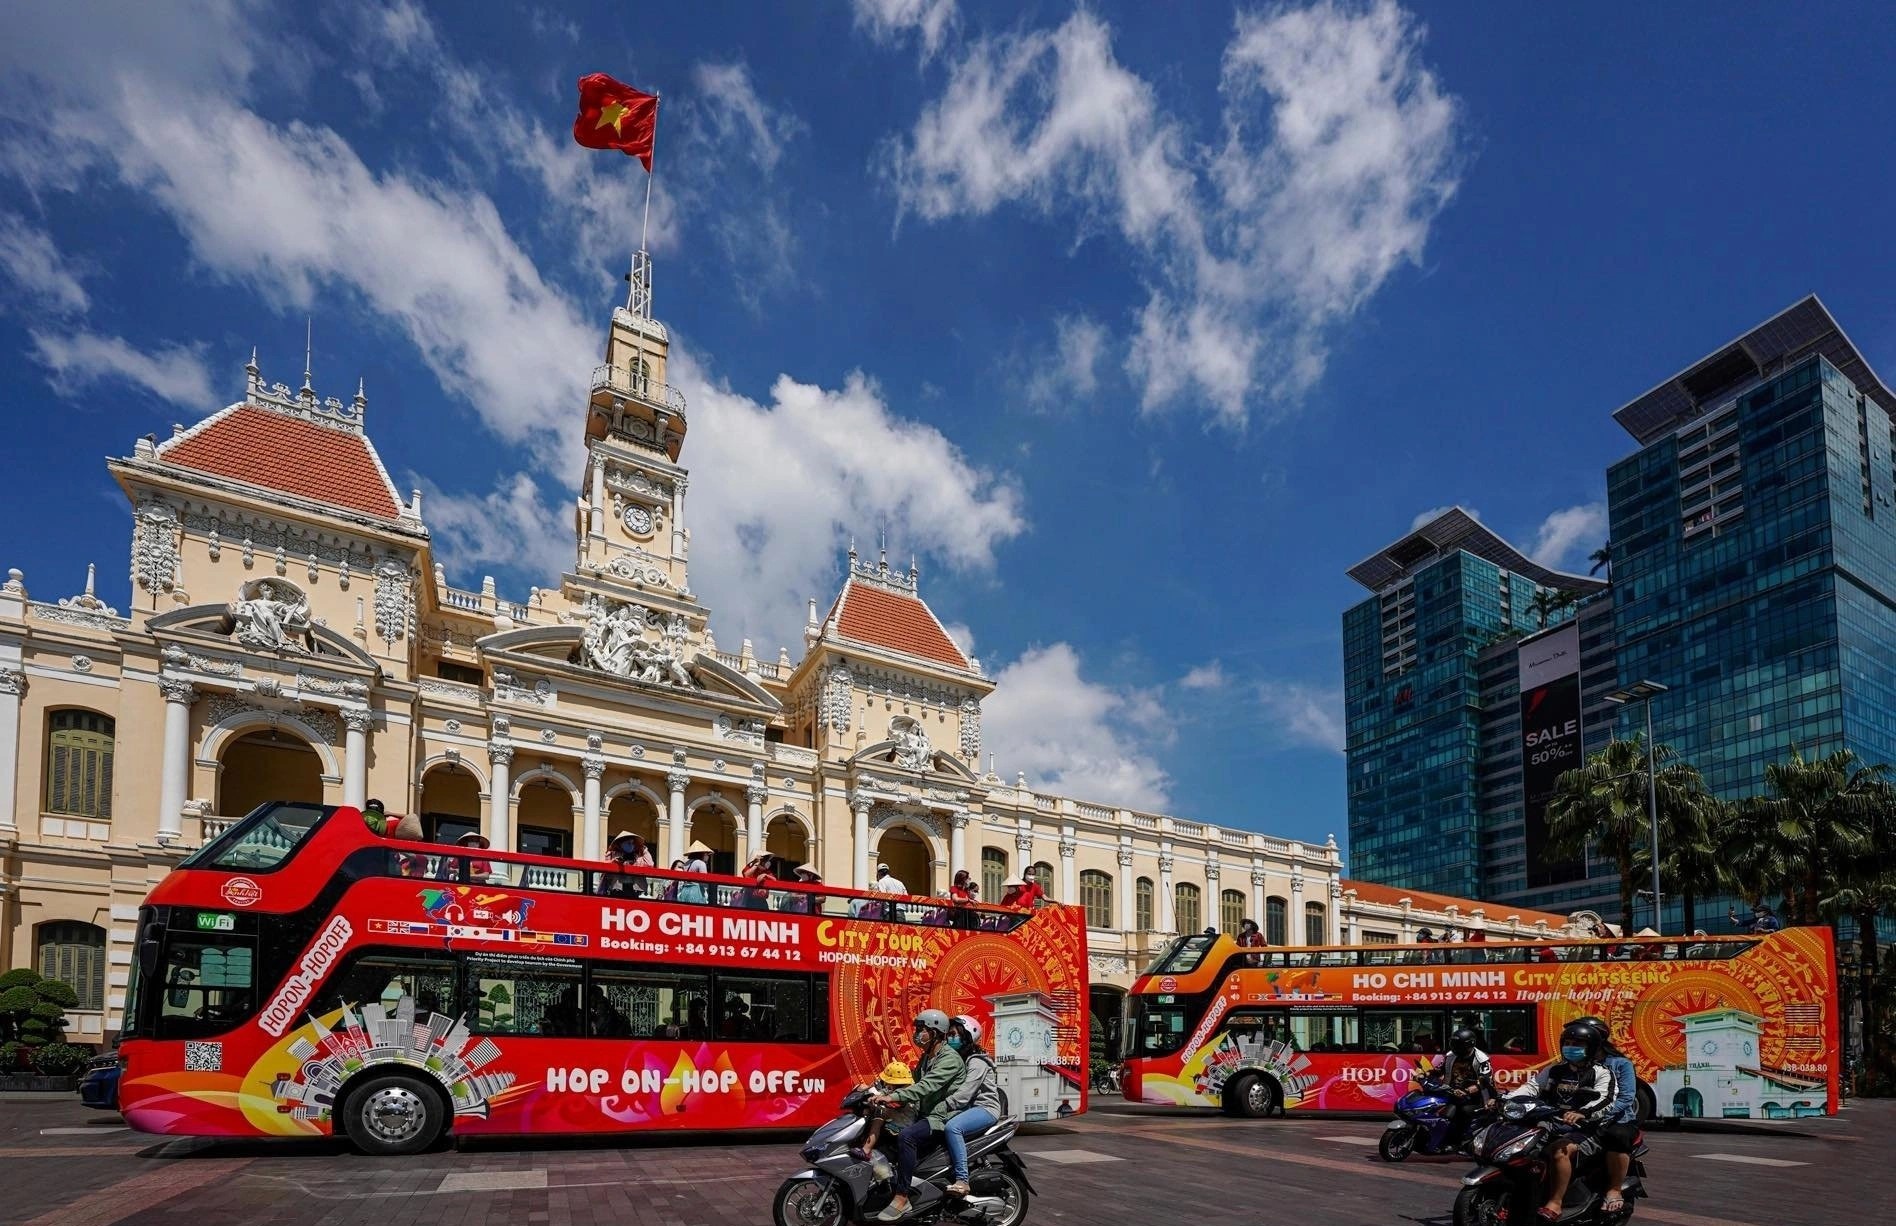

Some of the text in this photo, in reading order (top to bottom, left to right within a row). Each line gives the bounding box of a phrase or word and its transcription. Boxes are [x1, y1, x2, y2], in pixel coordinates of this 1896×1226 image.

[1526, 719, 1577, 747] SALE
[1531, 746, 1565, 765] 50%
[601, 907, 800, 945] HO CHI MINH
[600, 937, 801, 961] Booking: +84 913 67 44 12
[876, 932, 924, 952] TOUR
[818, 951, 927, 969] HOPON-HOPOFF.VN
[1353, 971, 1505, 988] HO CHI MINH
[1560, 971, 1670, 986] SIGHTSEEING
[1352, 991, 1507, 1003] Booking: +84 913 67 44 12
[546, 1067, 610, 1093] HOP
[749, 1070, 825, 1094] OFF.VN
[1342, 1067, 1387, 1082] HOP
